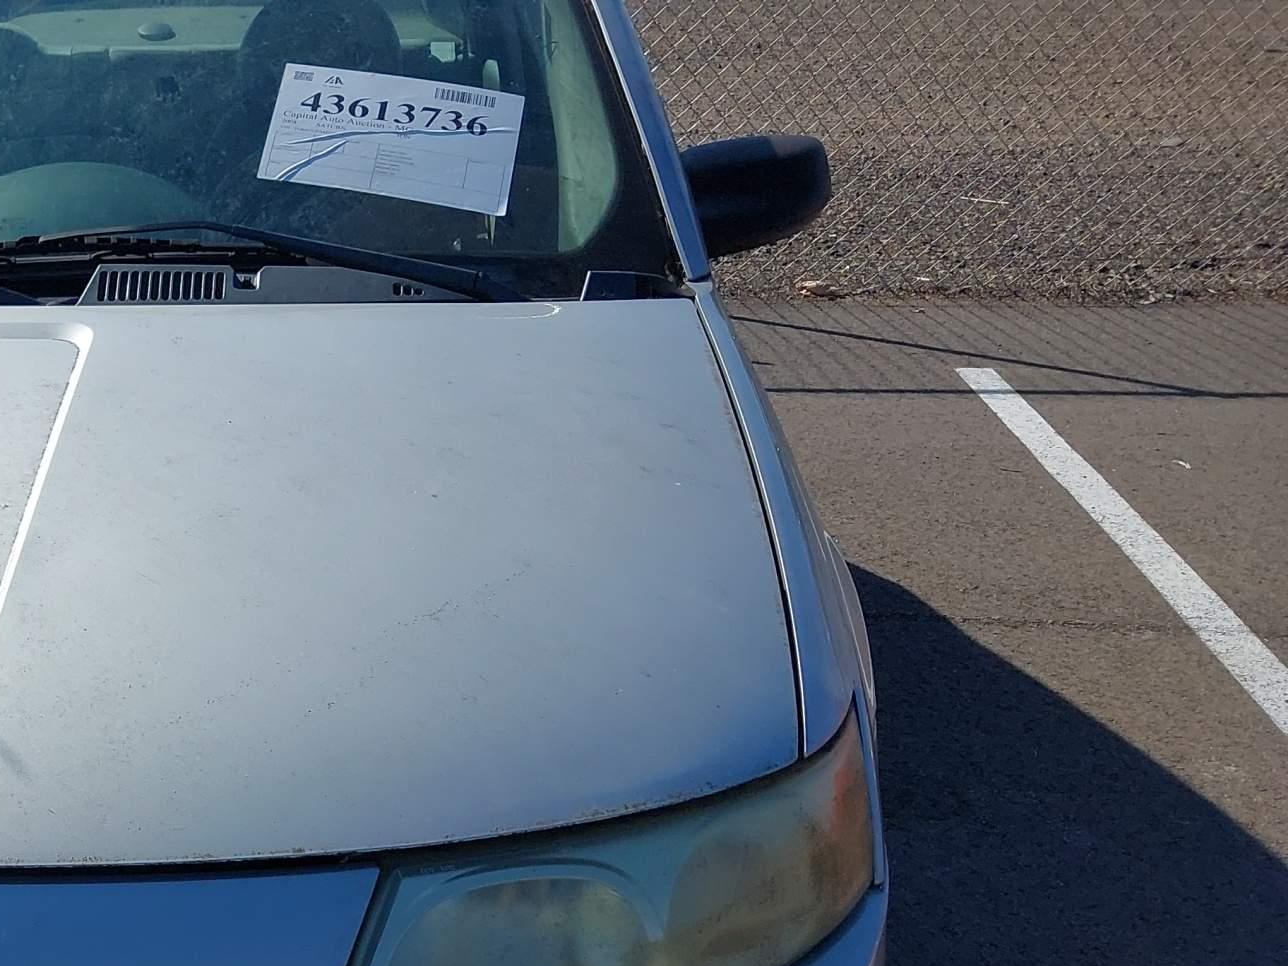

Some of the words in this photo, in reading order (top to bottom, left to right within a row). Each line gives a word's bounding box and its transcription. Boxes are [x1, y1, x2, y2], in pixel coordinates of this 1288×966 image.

[283, 110, 317, 120] Capital
[347, 118, 385, 129] Auction
[300, 91, 489, 136] 43613736
